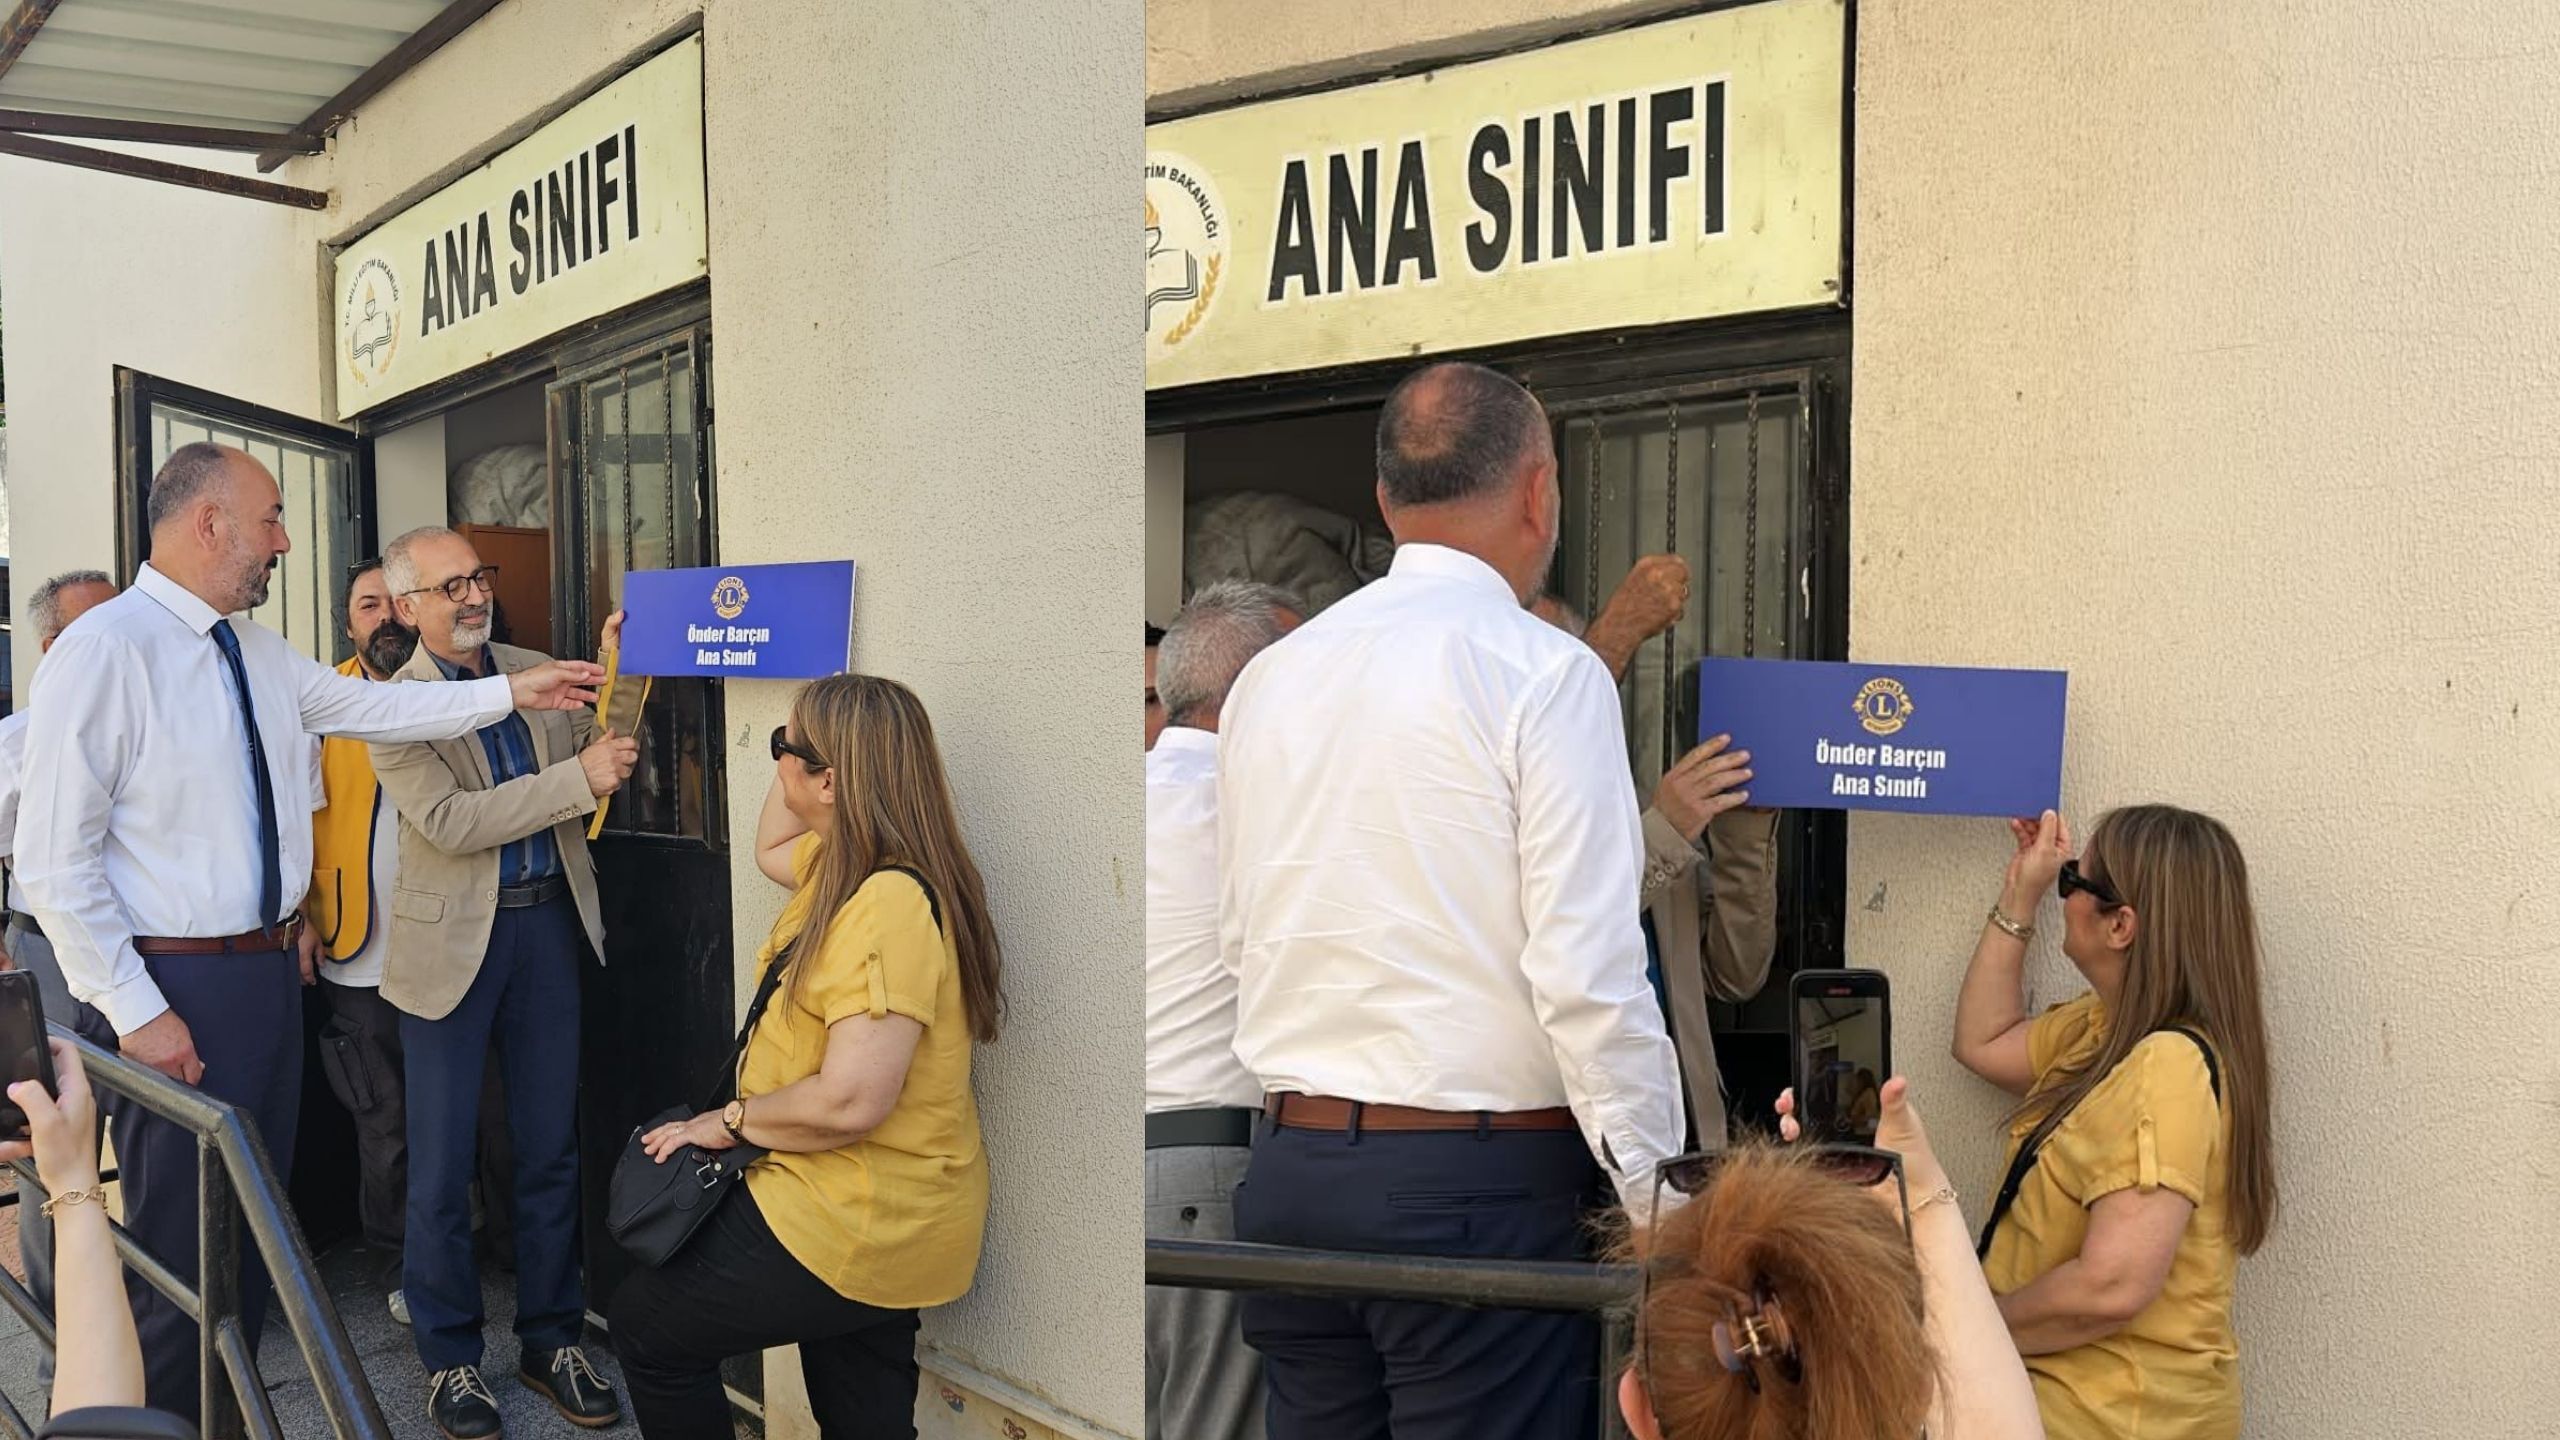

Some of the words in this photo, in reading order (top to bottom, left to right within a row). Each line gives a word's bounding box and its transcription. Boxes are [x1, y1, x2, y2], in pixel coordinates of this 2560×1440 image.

[1268, 141, 1437, 301] ANA
[1466, 81, 1725, 272] SINIFI
[1169, 168, 1219, 239] BAKANLIĞI
[422, 211, 498, 337] ANA
[509, 124, 639, 295] SINIFI
[720, 578, 742, 588] LIONS
[725, 590, 736, 605] L
[687, 624, 725, 643] Önder
[726, 626, 770, 646] Barçın
[695, 649, 721, 666] Ana
[722, 649, 757, 666] Sınıfı
[1866, 680, 1900, 692] LIONS
[1876, 696, 1892, 715] L
[1816, 738, 1877, 766] Önder
[1880, 744, 1946, 772] Barçın
[1832, 773, 1870, 796] Ana
[1874, 774, 1926, 798] Sınıfı
